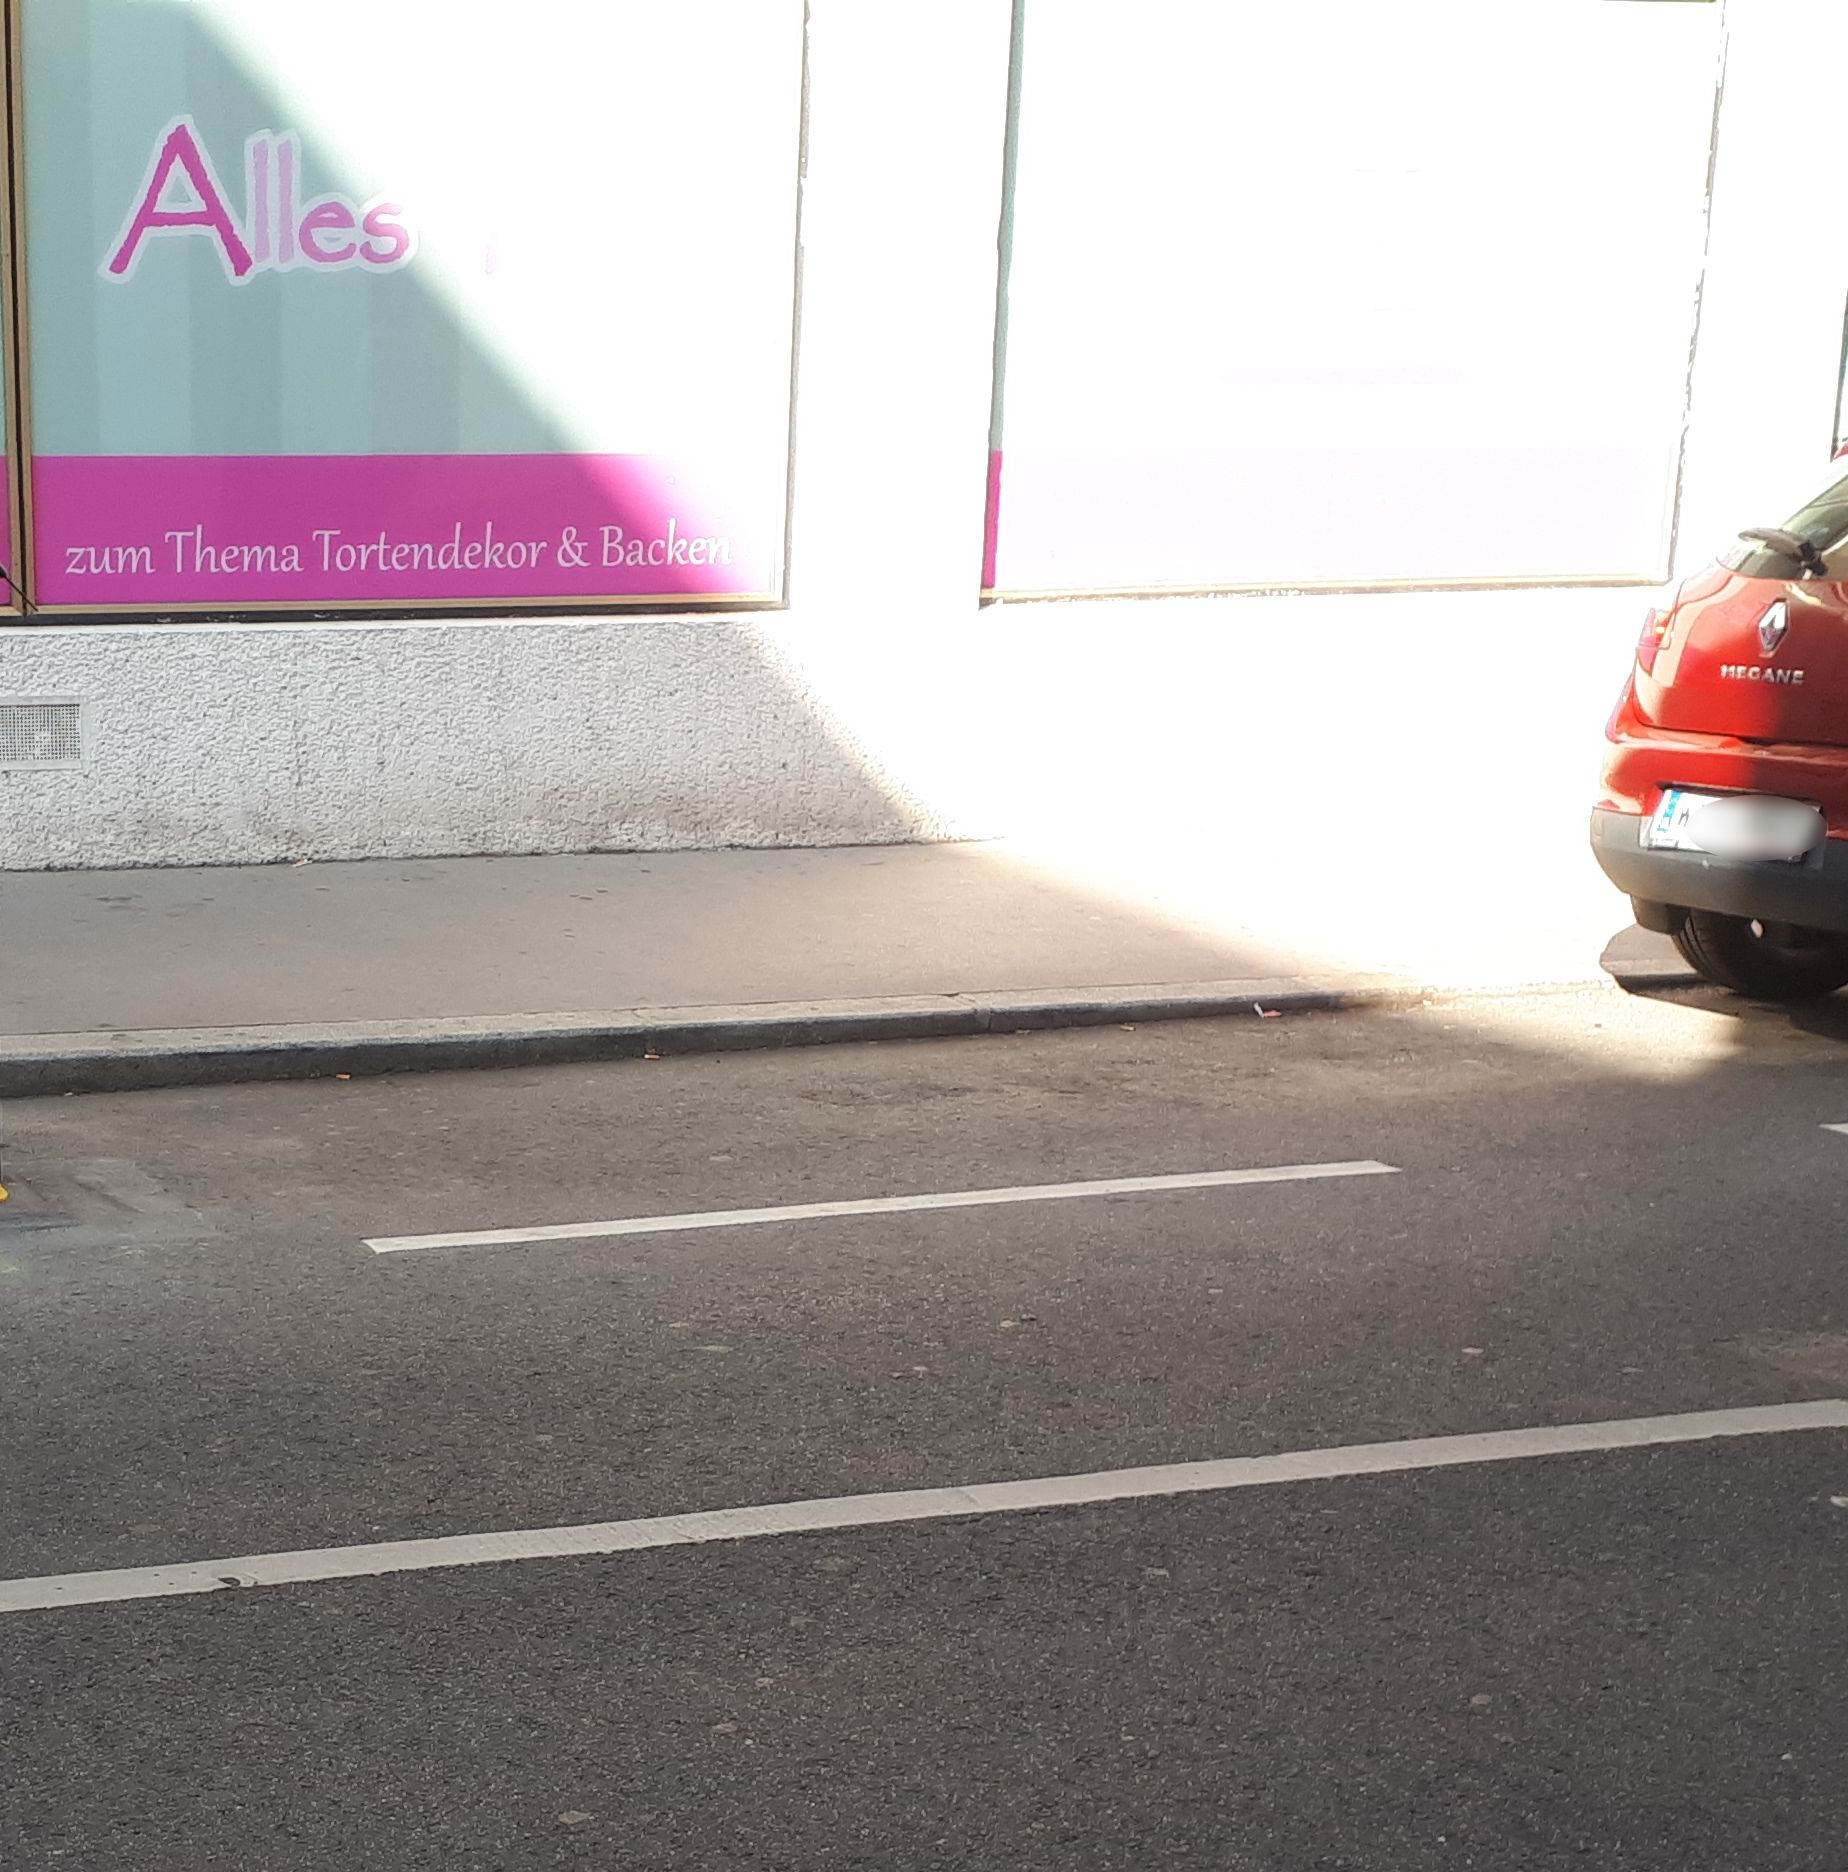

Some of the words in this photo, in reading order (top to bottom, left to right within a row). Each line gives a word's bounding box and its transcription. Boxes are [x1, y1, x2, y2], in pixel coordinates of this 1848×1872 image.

[109, 123, 409, 277] Alles
[66, 547, 155, 574] zum
[165, 524, 303, 574] Thema
[313, 521, 547, 572] Tortendekor
[556, 526, 592, 569] &
[599, 517, 733, 568] Backen
[1720, 664, 1805, 685] MEGANE
